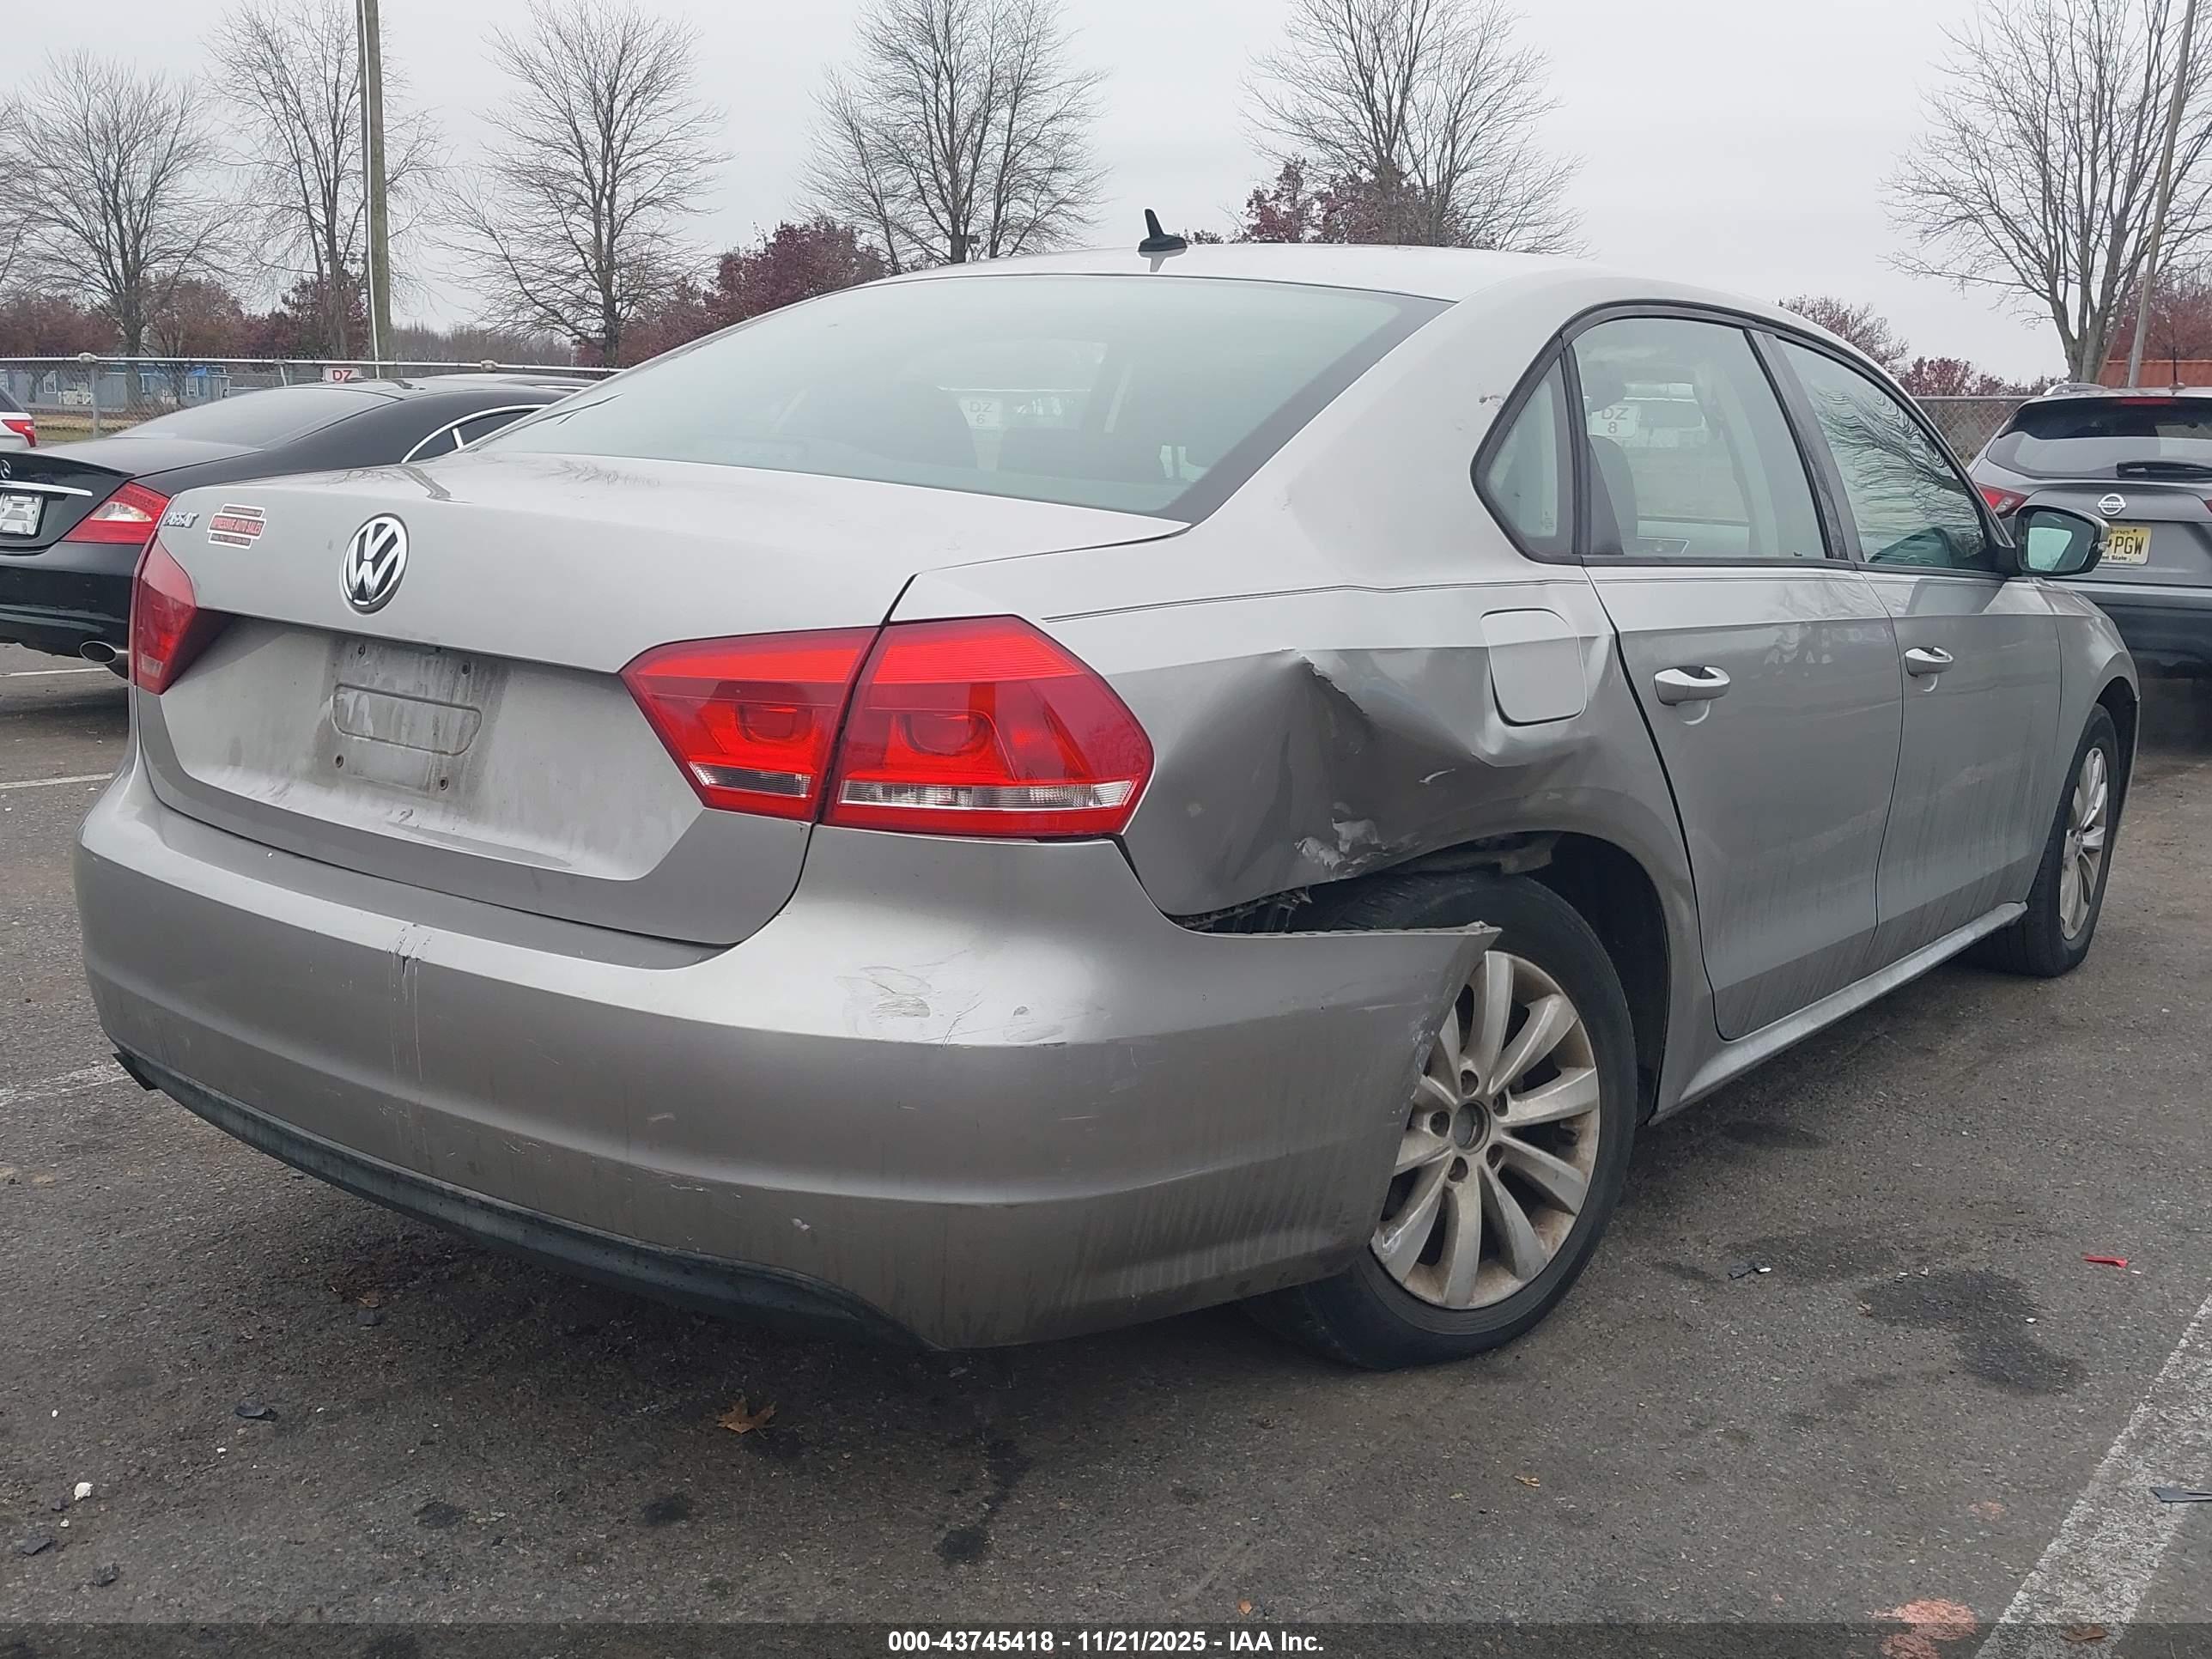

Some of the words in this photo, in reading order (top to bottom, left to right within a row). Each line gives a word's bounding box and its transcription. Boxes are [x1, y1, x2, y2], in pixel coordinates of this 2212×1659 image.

[333, 370, 352, 381] DZ
[969, 402, 992, 412] DZ
[976, 414, 985, 424] 6
[1601, 408, 1628, 420] DZ
[1607, 422, 1618, 434] 8
[246, 520, 263, 535] SALES
